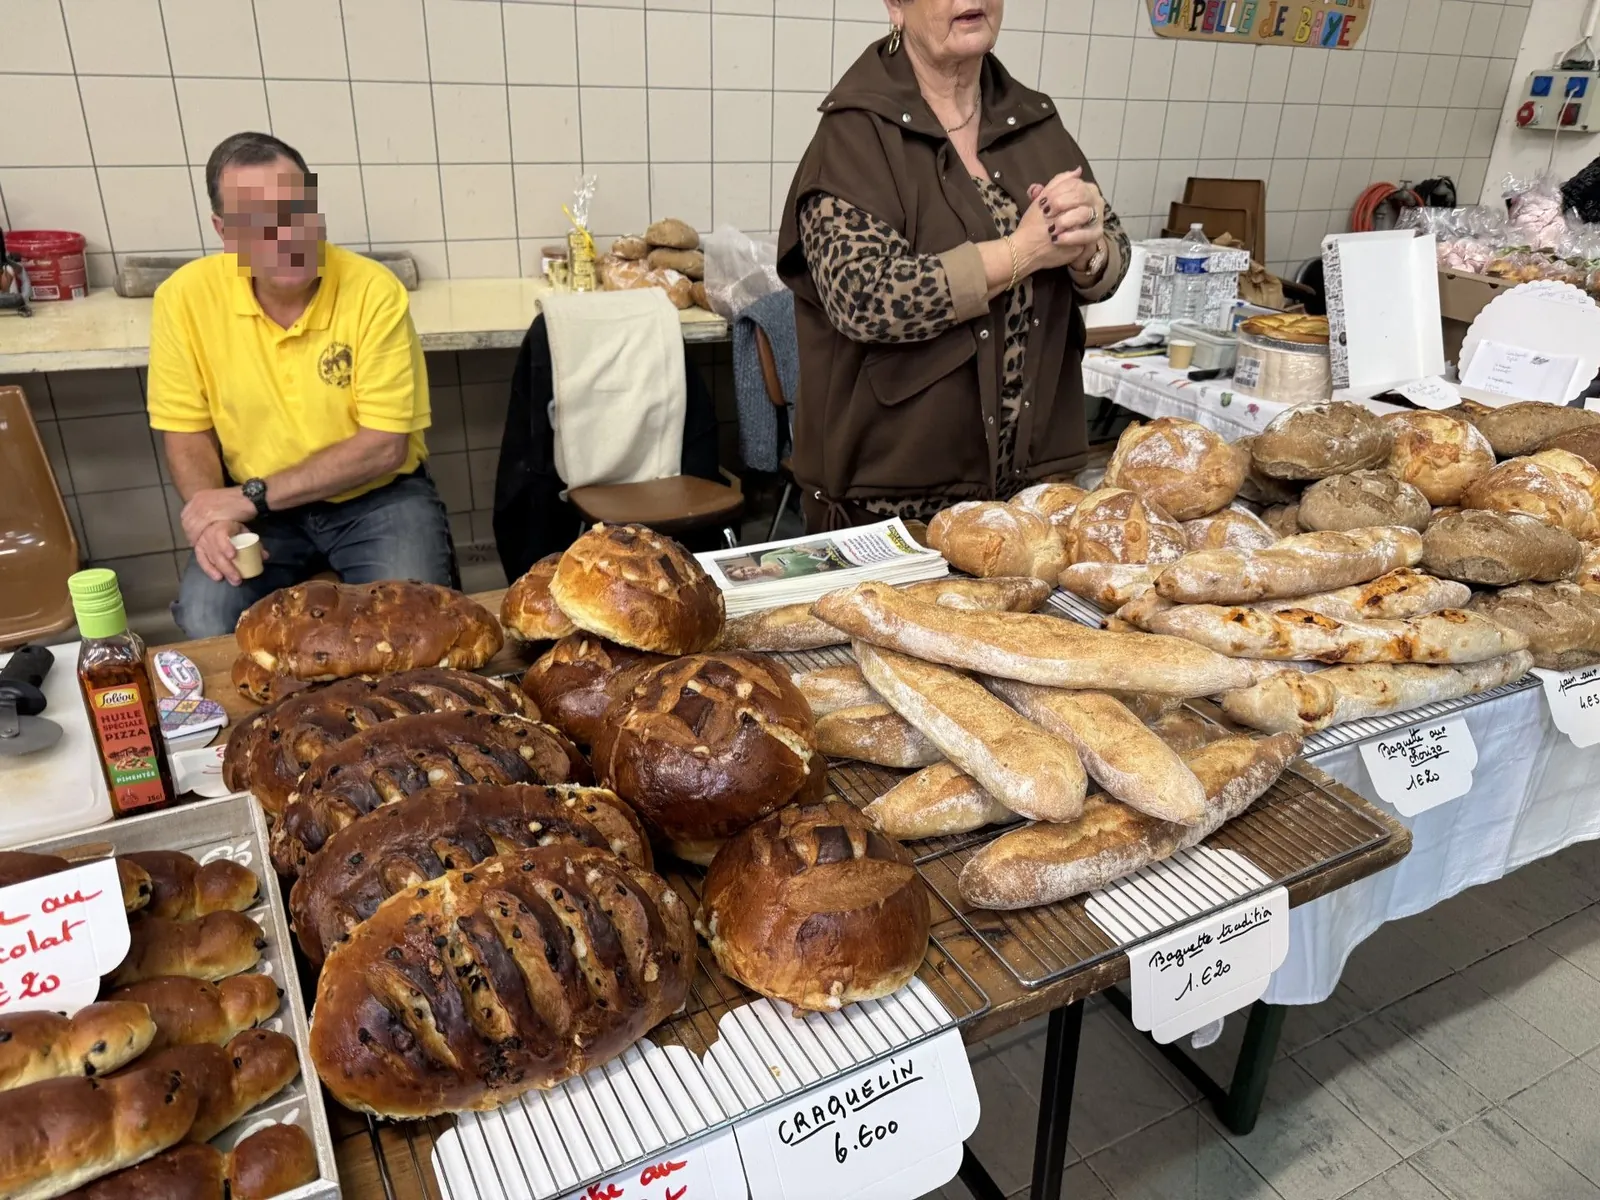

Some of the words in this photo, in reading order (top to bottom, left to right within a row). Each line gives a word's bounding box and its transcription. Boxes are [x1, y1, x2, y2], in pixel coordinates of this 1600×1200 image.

[1154, 0, 1257, 34] CHAPELLE
[1293, 6, 1356, 47] BAYE
[101, 709, 141, 723] HUILE
[105, 728, 147, 742] PIZZA
[1378, 728, 1424, 758] Baguette
[1409, 744, 1442, 763] chorizo
[41, 889, 103, 914] au
[1149, 932, 1214, 968] Baguette
[640, 1160, 689, 1186] au
